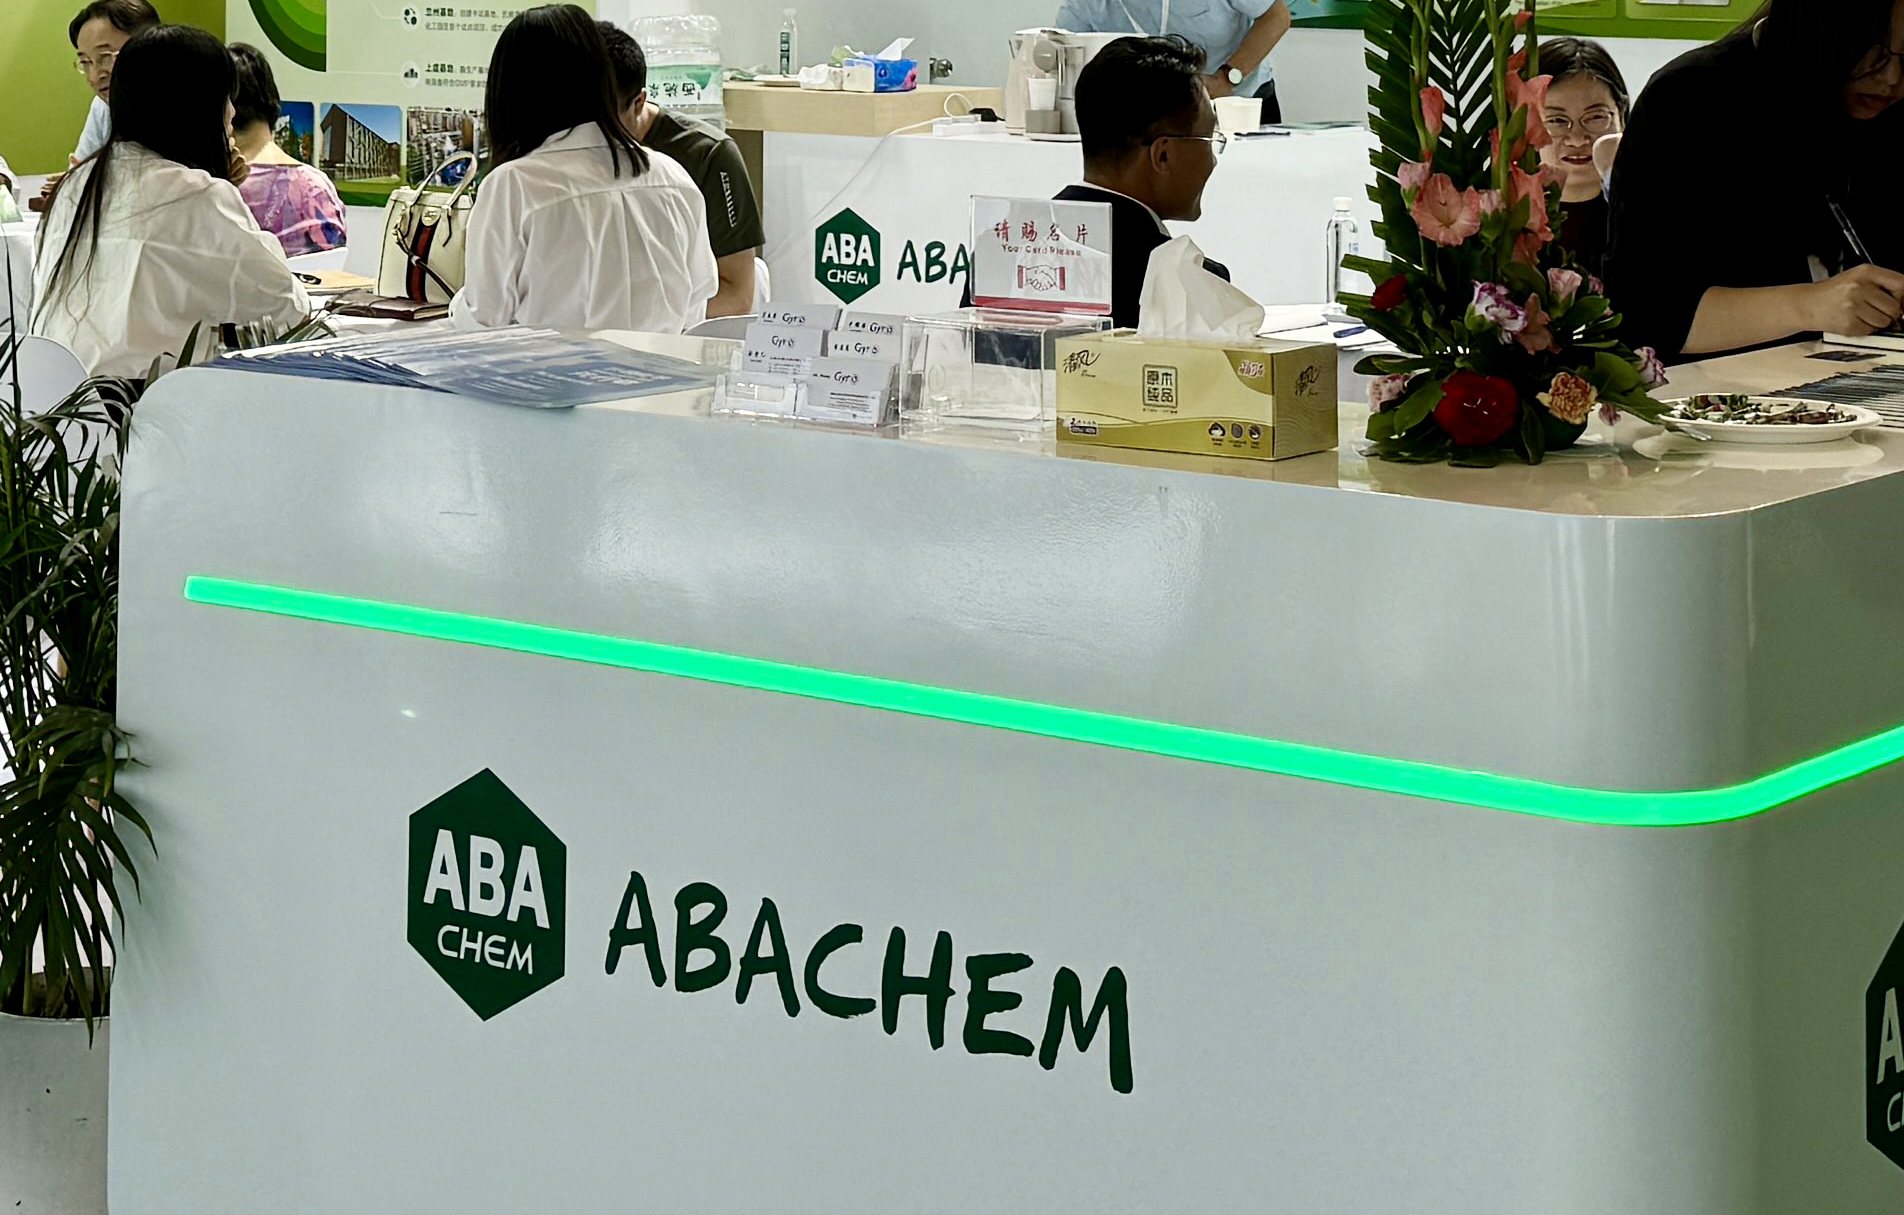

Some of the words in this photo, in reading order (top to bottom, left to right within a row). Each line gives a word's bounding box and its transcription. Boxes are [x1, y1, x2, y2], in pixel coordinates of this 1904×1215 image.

[820, 231, 875, 268] ABA
[827, 270, 869, 285] CHEM
[423, 829, 550, 929] ABA
[437, 924, 533, 975] CHEM
[605, 871, 1133, 1094] ABACHEM
